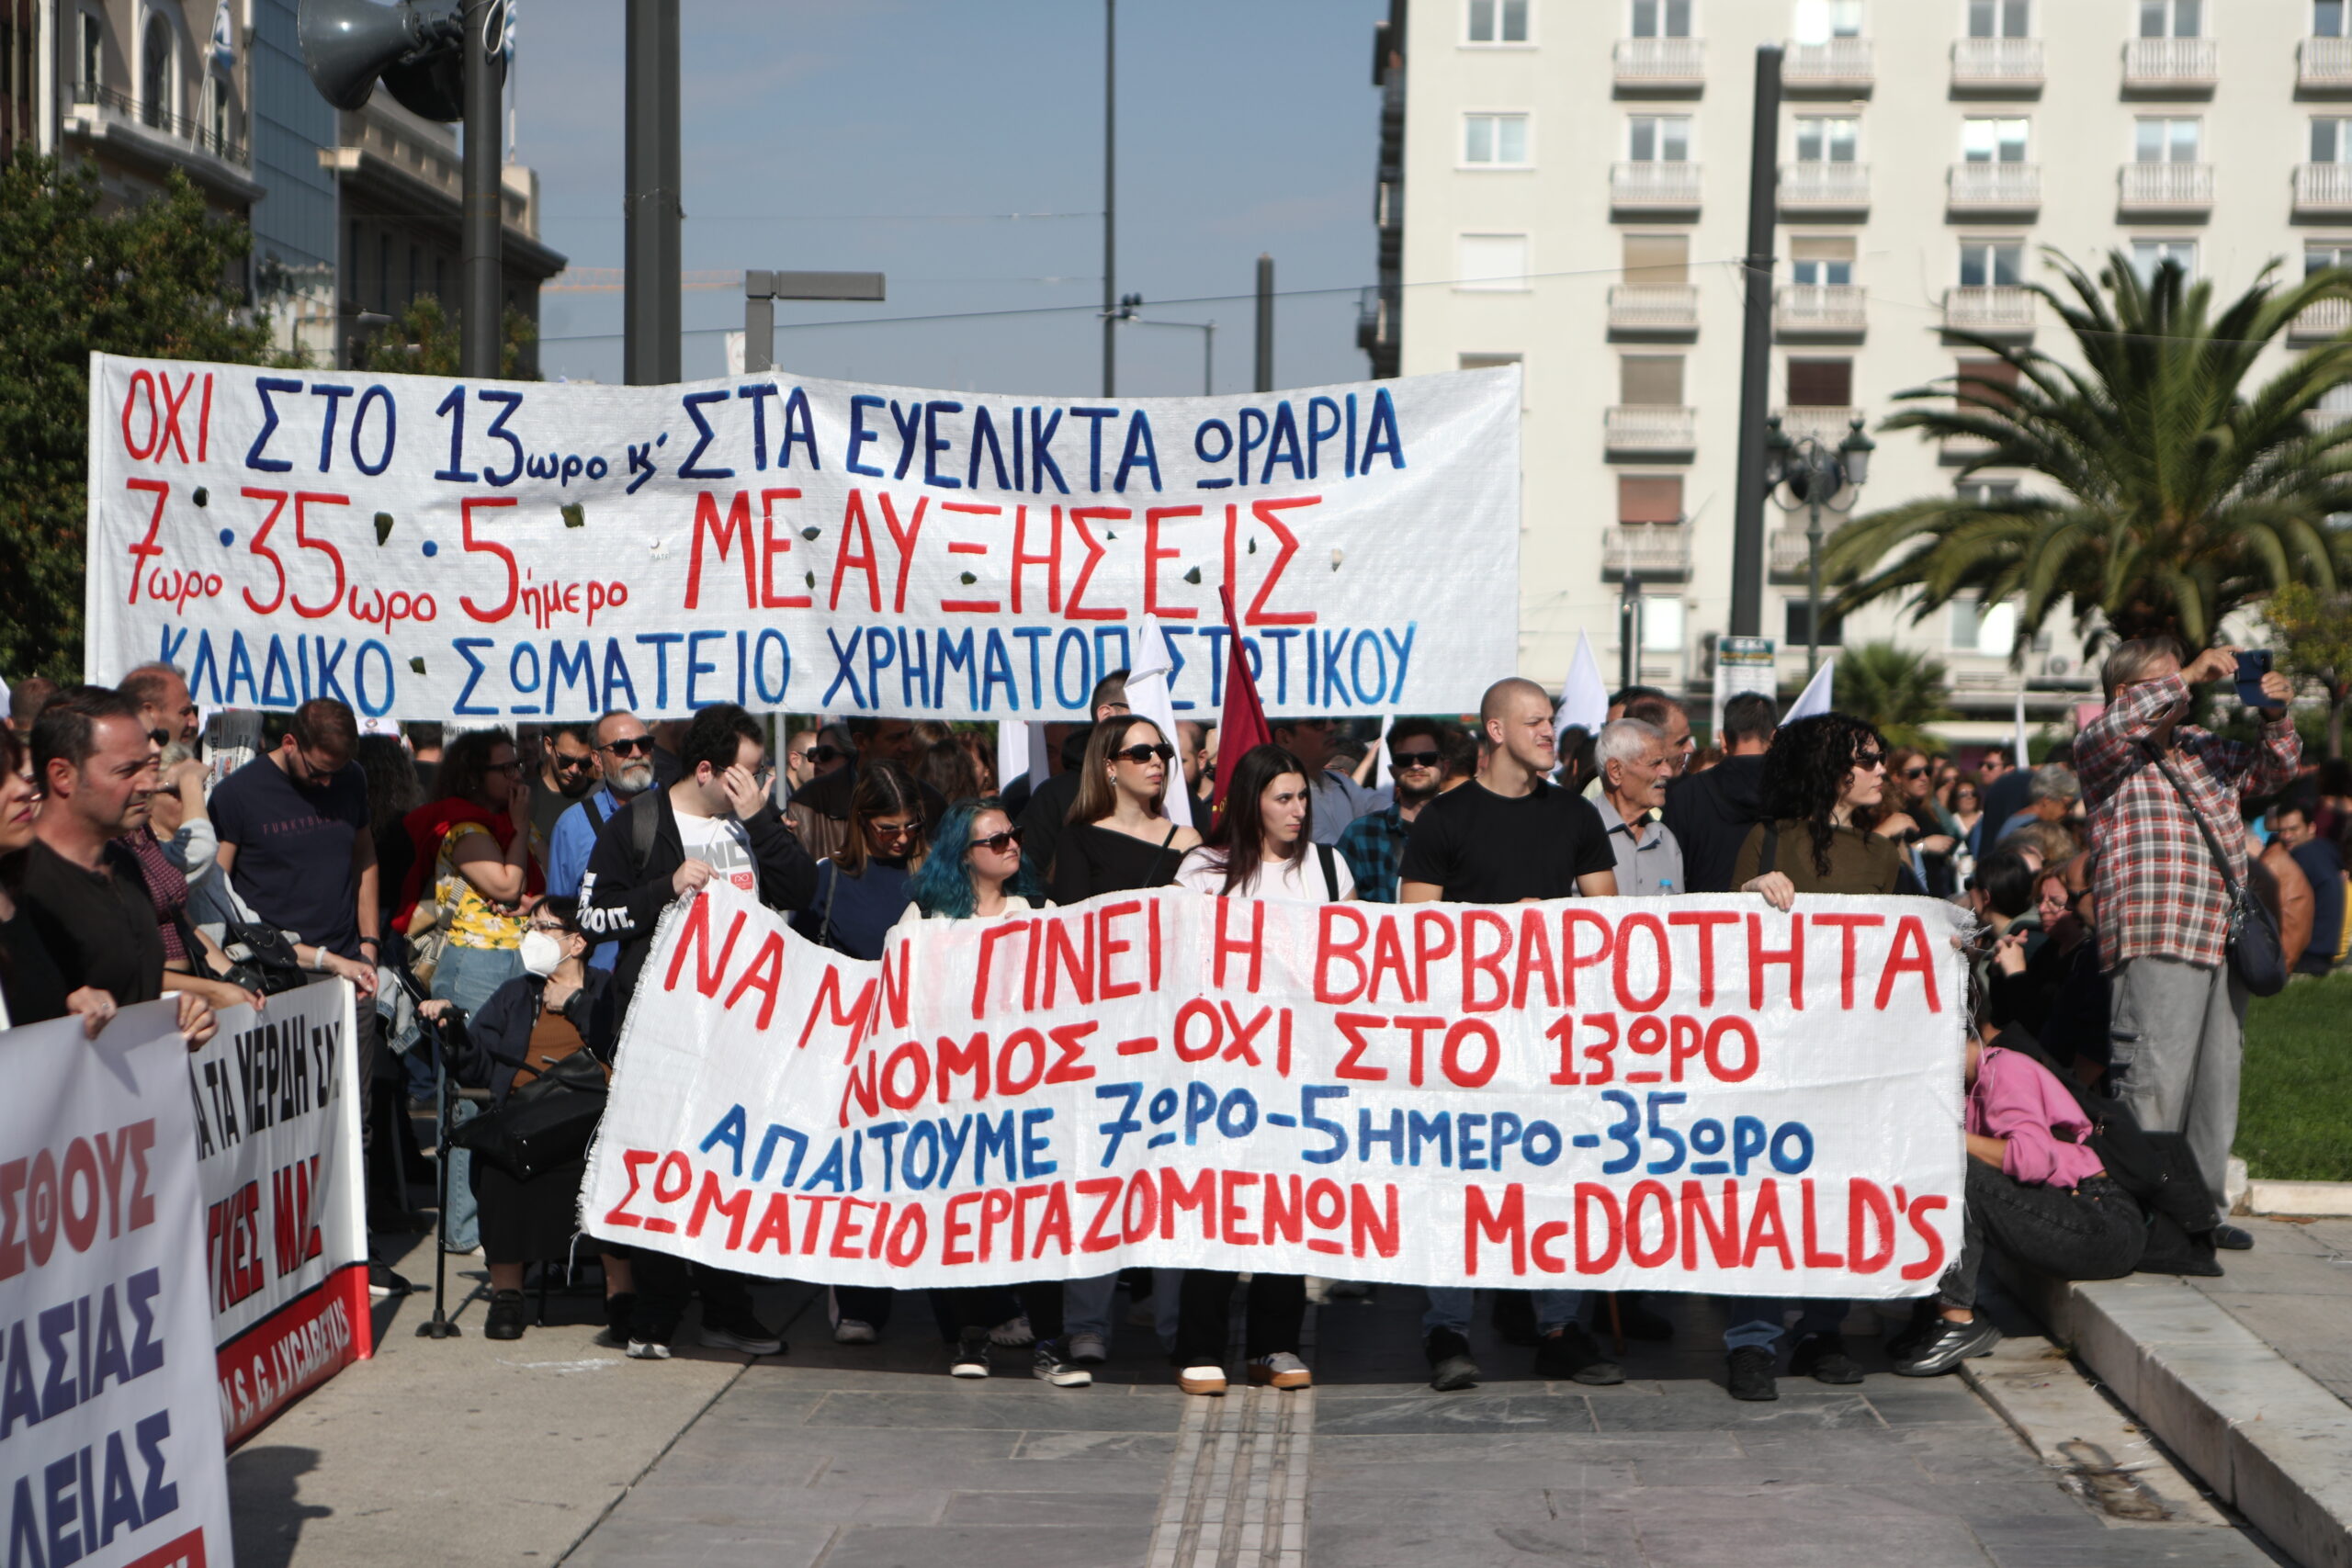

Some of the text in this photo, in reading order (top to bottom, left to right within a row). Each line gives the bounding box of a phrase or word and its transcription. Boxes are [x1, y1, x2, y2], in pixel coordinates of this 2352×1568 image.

[122, 369, 213, 463] ΟΧΙ
[245, 377, 395, 474] ΣΤΟ
[435, 385, 606, 485] 13ωρο
[677, 384, 820, 477] ΣΤΑ
[846, 395, 1162, 494] ΕΥΕΛΙΚΤΑ
[1196, 387, 1407, 487] ΩΡΑΡΙΑ
[127, 478, 1322, 634] 7ωρο 35ωρο 5ήμερο ΜΕ ΑΥΞΗΣΕΙΣ
[451, 627, 791, 716] ΣΩΜΑΤΕΙΟ
[822, 621, 1418, 712] ΧΡΗΜΑΤΟΠΣΤΤΙΚΟΥ
[664, 892, 785, 1031] ΝΑ
[798, 939, 910, 1066] ΜΝ
[972, 898, 1161, 1020] ΓΙΝΕΙ
[1213, 895, 1264, 994] Η
[1313, 906, 1941, 1013] ΒΑΡΒΑΡΟΤΗΤΑ
[204, 1058, 241, 1150] ΤΑ
[840, 1021, 1099, 1128] ΝΟΜΟΣ
[1174, 998, 1293, 1077] ΟΧΙ
[1334, 1012, 1500, 1088] ΣΤΟ
[1545, 1012, 1759, 1085] 13ΩΡΟ
[697, 1104, 1058, 1193] ΑΠΑΙΤΟΥΜΕ
[605, 1149, 1948, 1280] ΣΩΜΑΤΕΙΟ ΕΡΓΑΖΟΜΕΝΩΝ McDONALD'S
[0, 1267, 164, 1441] ΑΣΙΑΣ
